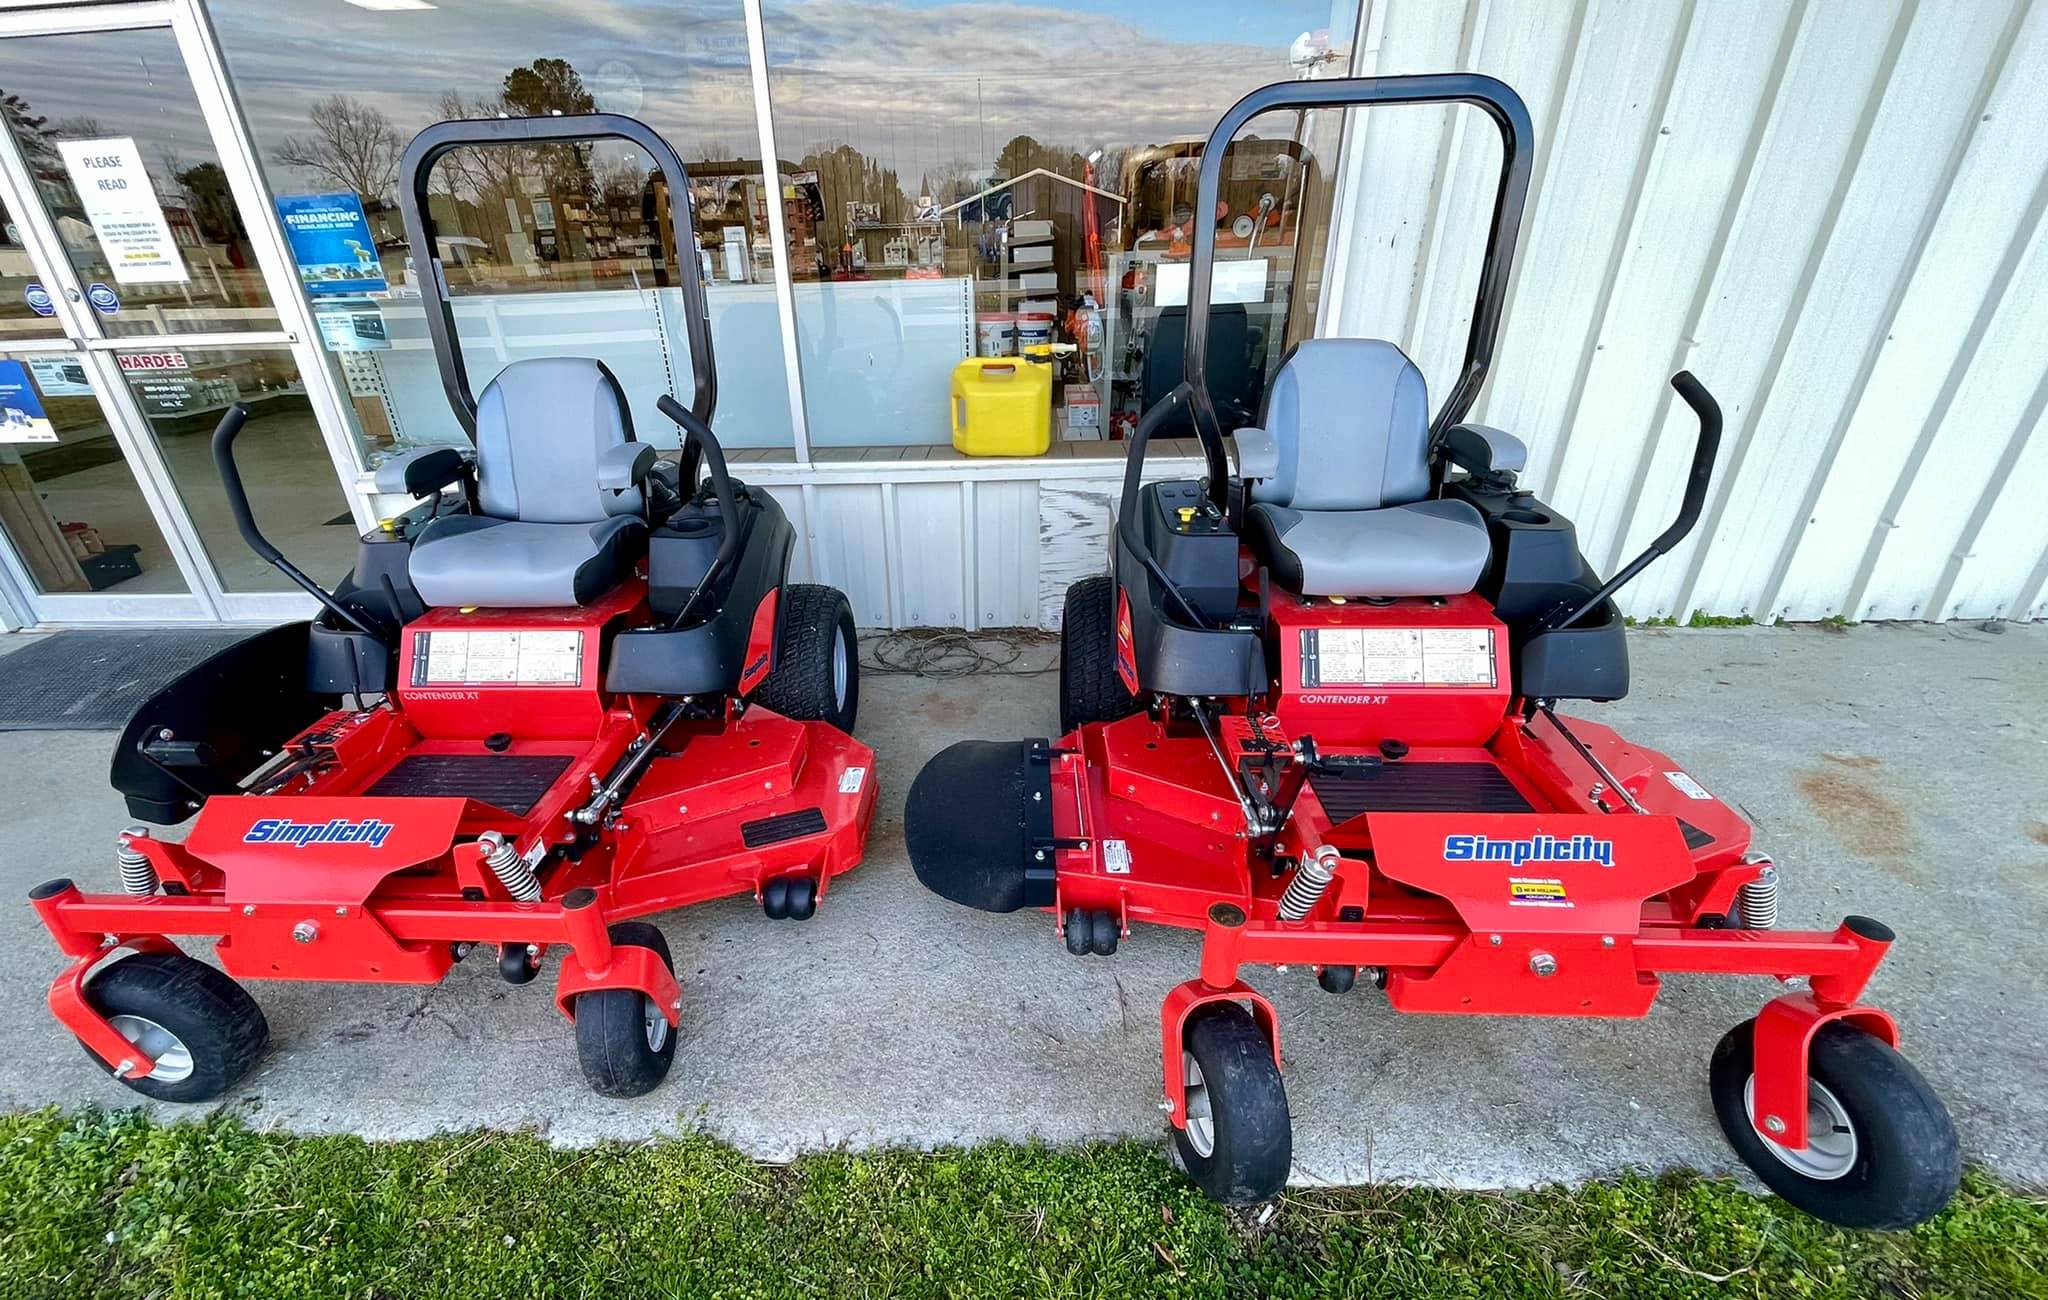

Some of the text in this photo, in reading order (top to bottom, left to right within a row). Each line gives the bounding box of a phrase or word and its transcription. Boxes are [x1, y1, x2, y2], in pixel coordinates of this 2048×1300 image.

[82, 155, 123, 169] PLEASE
[97, 178, 128, 191] READ
[285, 211, 360, 224] FINANCING
[118, 353, 188, 369] HARDEE
[403, 691, 480, 701] CONTENDER XT
[1299, 695, 1388, 704] CONTENDER XT
[243, 819, 394, 847] Simplicity
[1444, 835, 1615, 867] Simplicity
